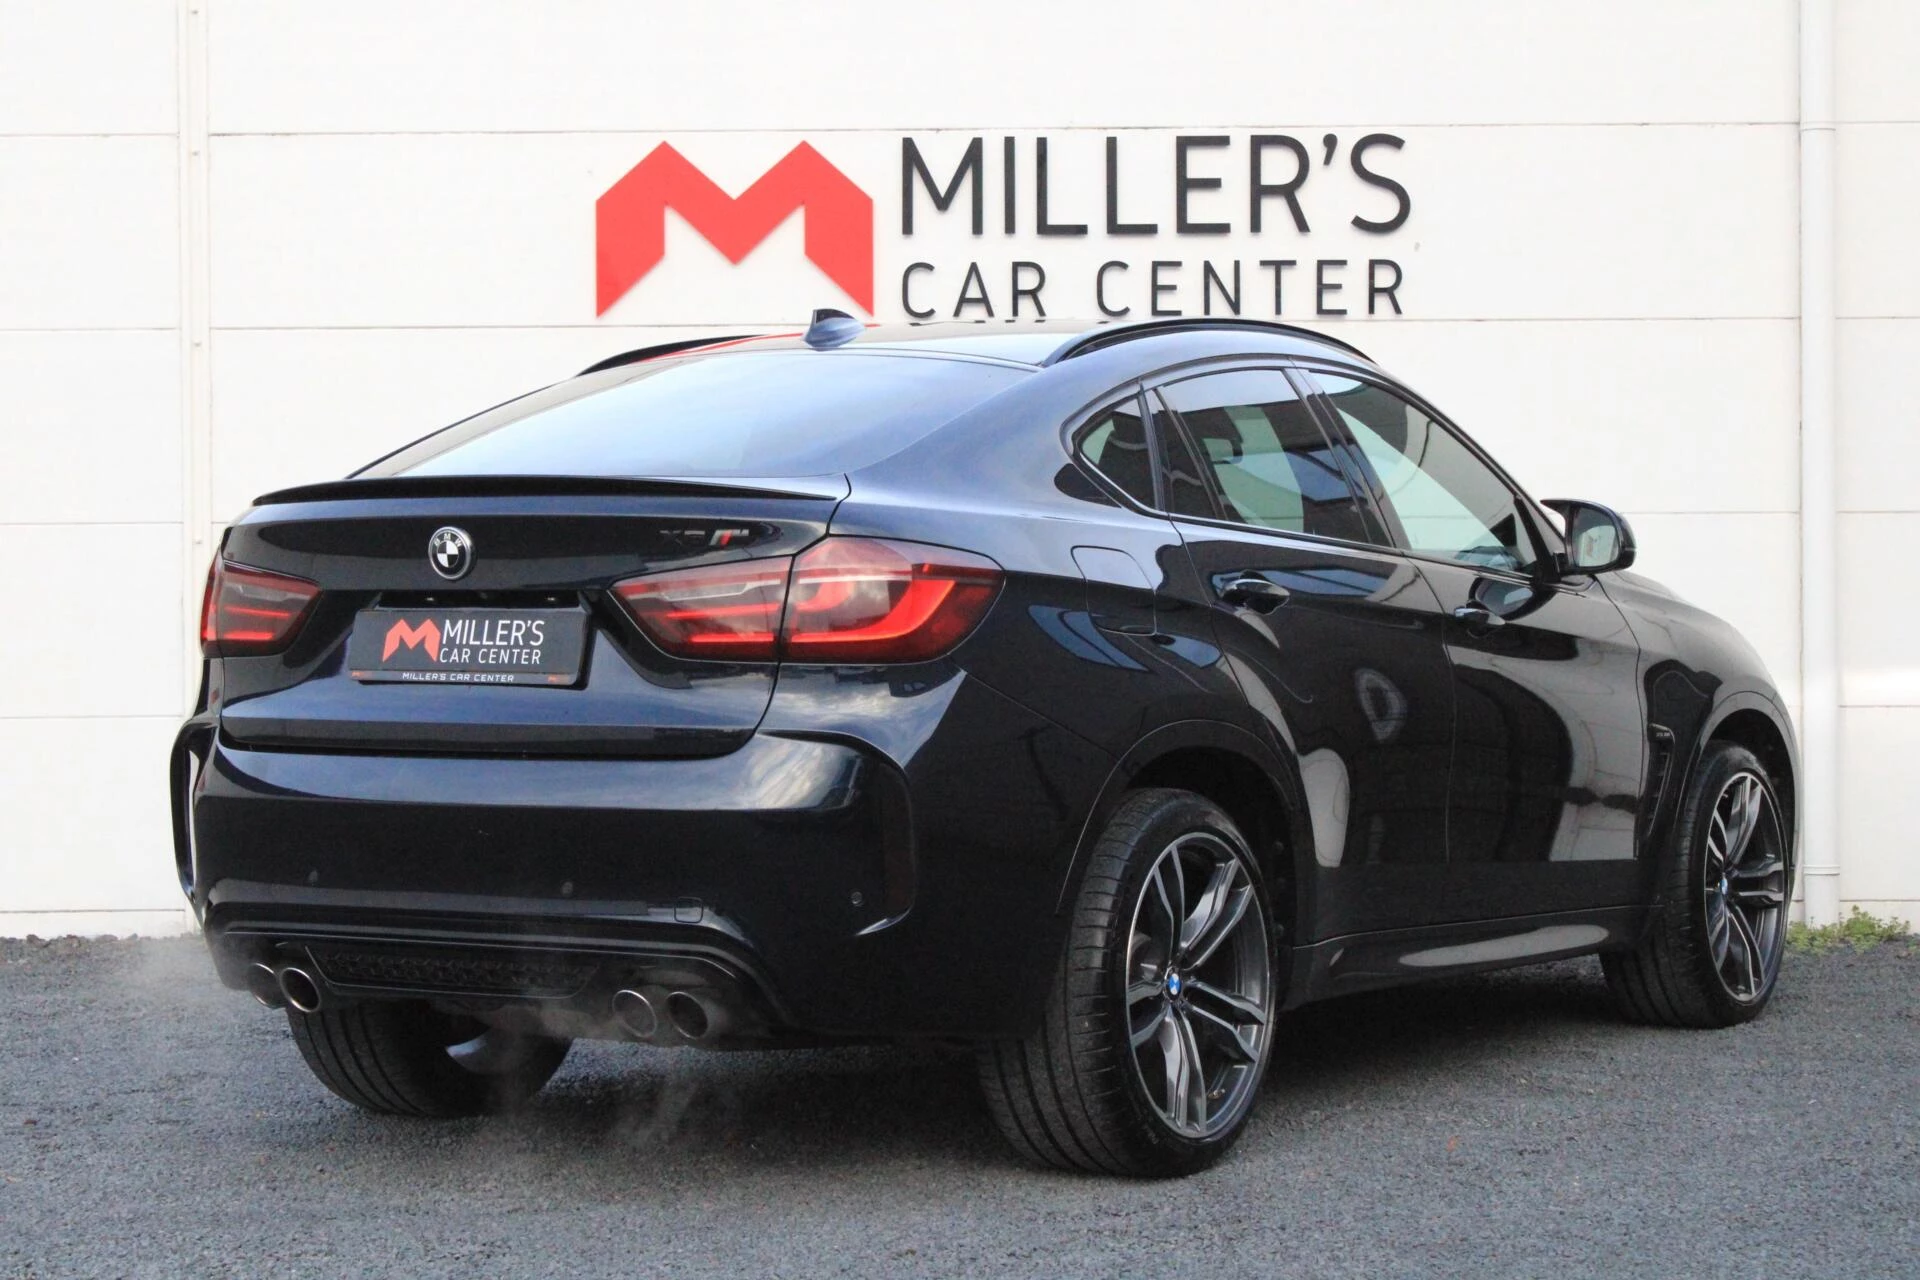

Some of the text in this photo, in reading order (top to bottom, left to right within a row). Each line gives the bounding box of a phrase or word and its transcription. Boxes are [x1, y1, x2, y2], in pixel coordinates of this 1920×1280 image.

[901, 133, 1412, 237] MILLER'S
[901, 259, 1402, 319] CAR CENTER
[442, 619, 545, 647] MILLER'S
[439, 647, 542, 665] CAR CENTER
[449, 673, 471, 682] CAR
[473, 674, 515, 683] CENTER
